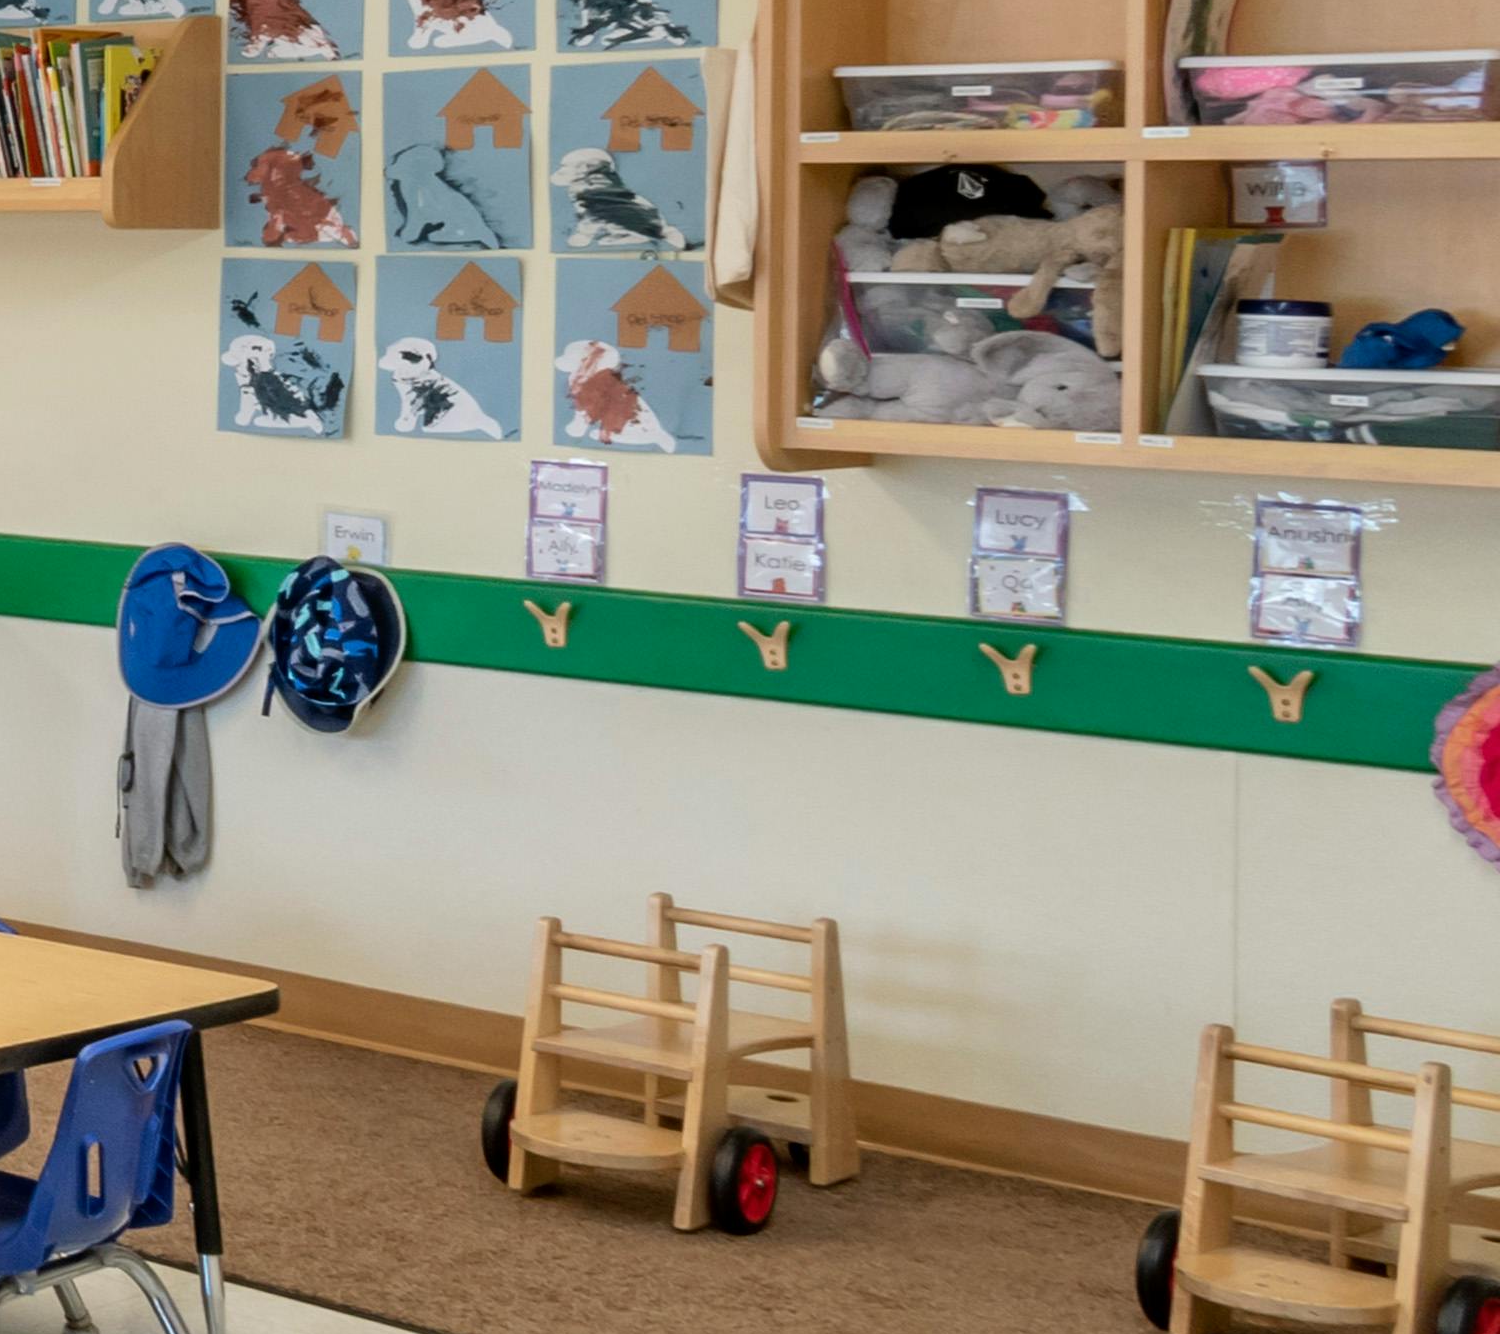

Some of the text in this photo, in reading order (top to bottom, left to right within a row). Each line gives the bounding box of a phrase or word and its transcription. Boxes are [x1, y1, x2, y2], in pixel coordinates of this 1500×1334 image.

[764, 494, 801, 511] Leo
[995, 509, 1047, 530] Lucy
[334, 525, 376, 542] Erwin
[754, 553, 806, 572] Katie
